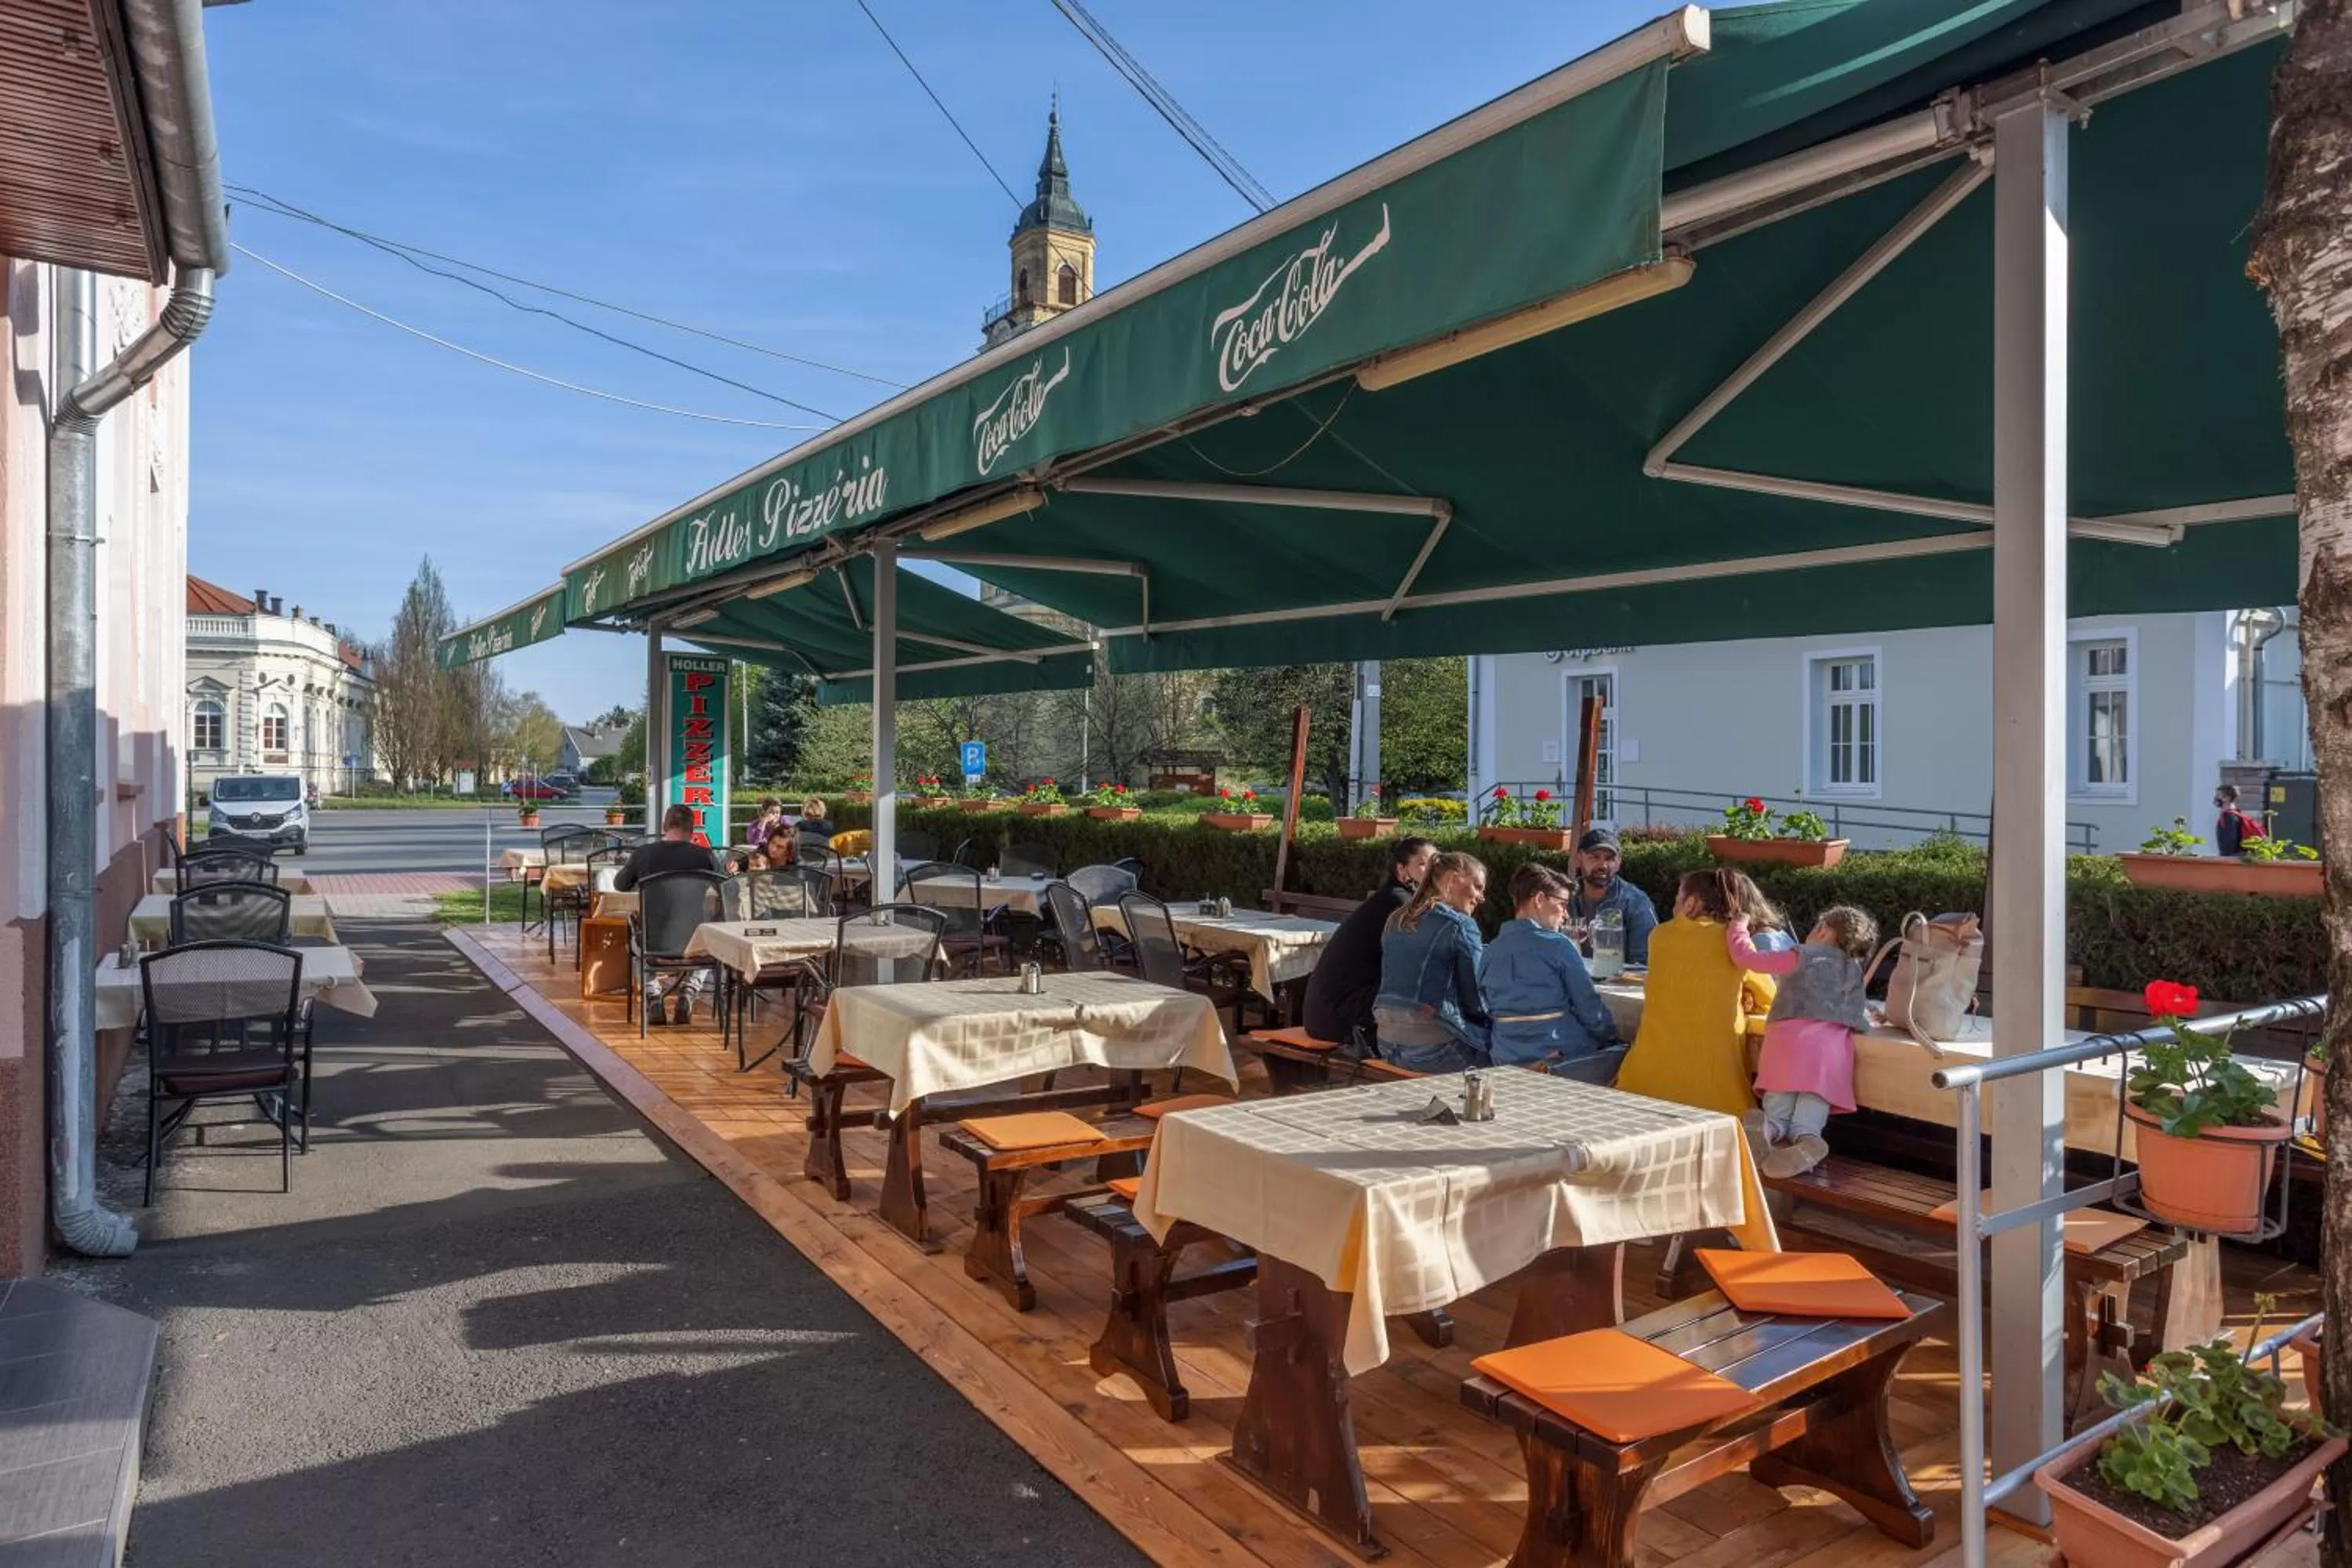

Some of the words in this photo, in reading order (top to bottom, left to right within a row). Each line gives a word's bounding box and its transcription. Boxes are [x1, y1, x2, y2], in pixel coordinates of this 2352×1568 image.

[1211, 202, 1390, 392] Coca-Cola
[758, 455, 888, 548] Pizzéria
[673, 659, 726, 672] HOLLER
[967, 746, 979, 766] P
